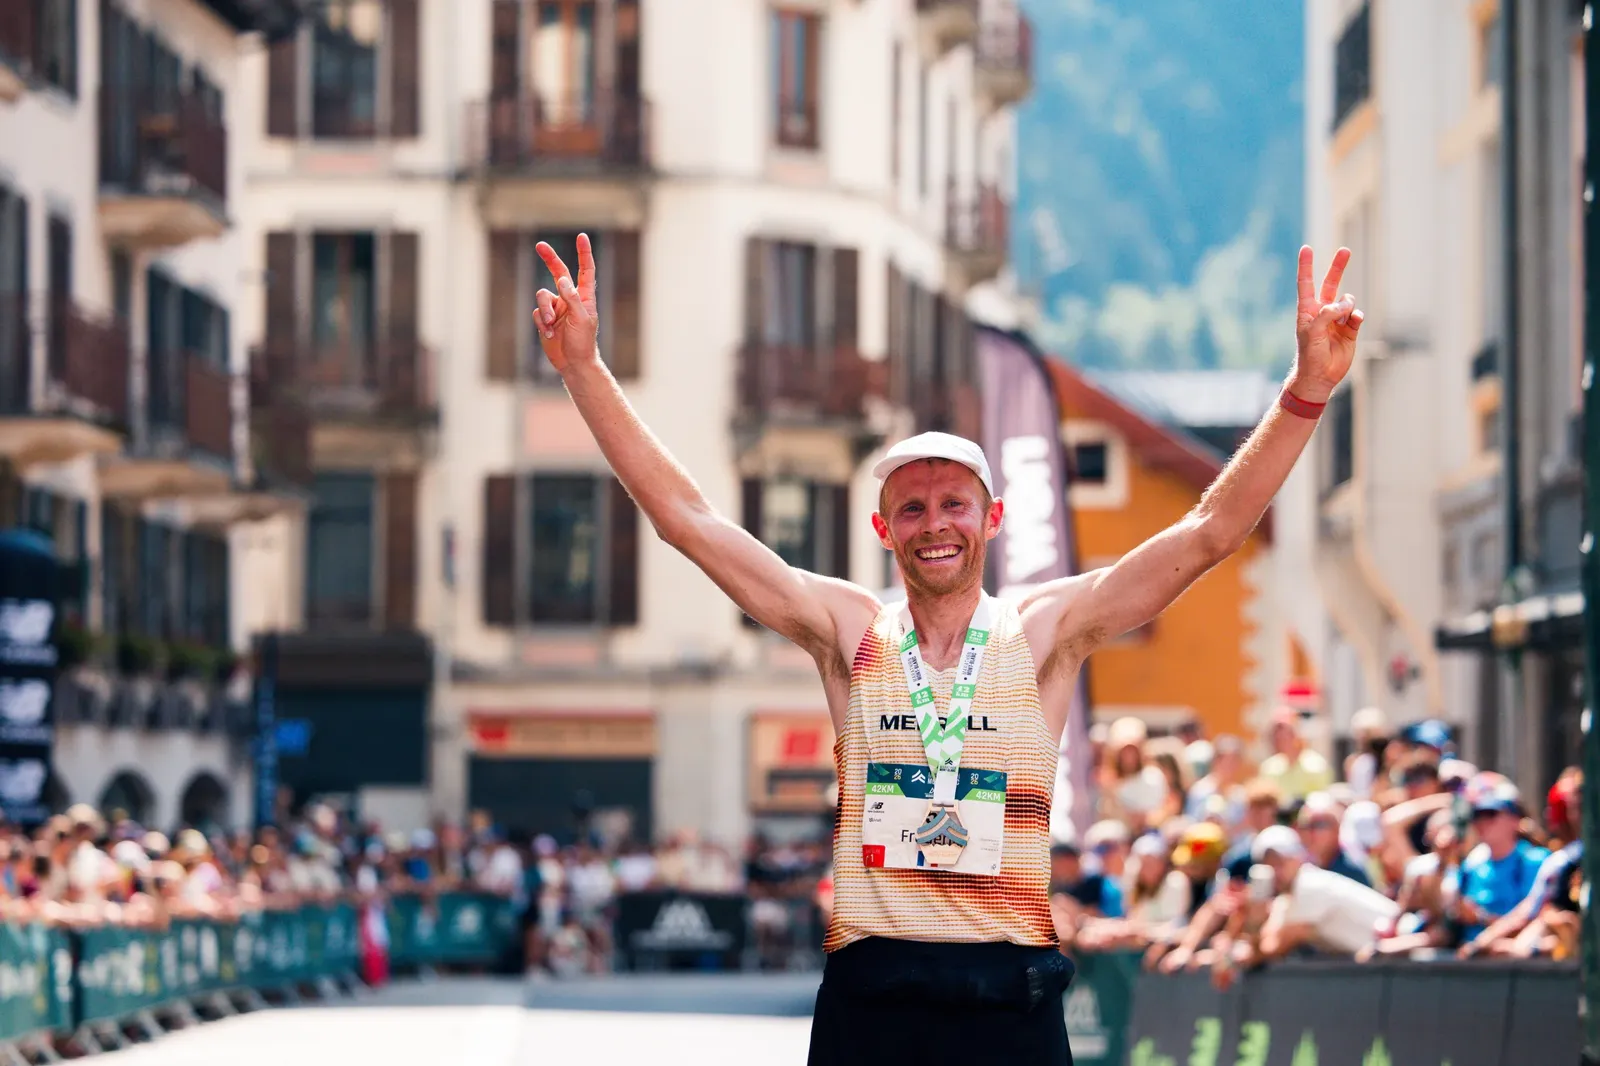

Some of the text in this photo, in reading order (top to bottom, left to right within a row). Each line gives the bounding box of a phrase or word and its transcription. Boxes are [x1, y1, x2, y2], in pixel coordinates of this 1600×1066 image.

[956, 685, 970, 693] 42
[914, 690, 929, 700] 42
[970, 772, 979, 780] 20
[871, 784, 895, 794] 42KM
[976, 790, 1001, 802] 42KM
